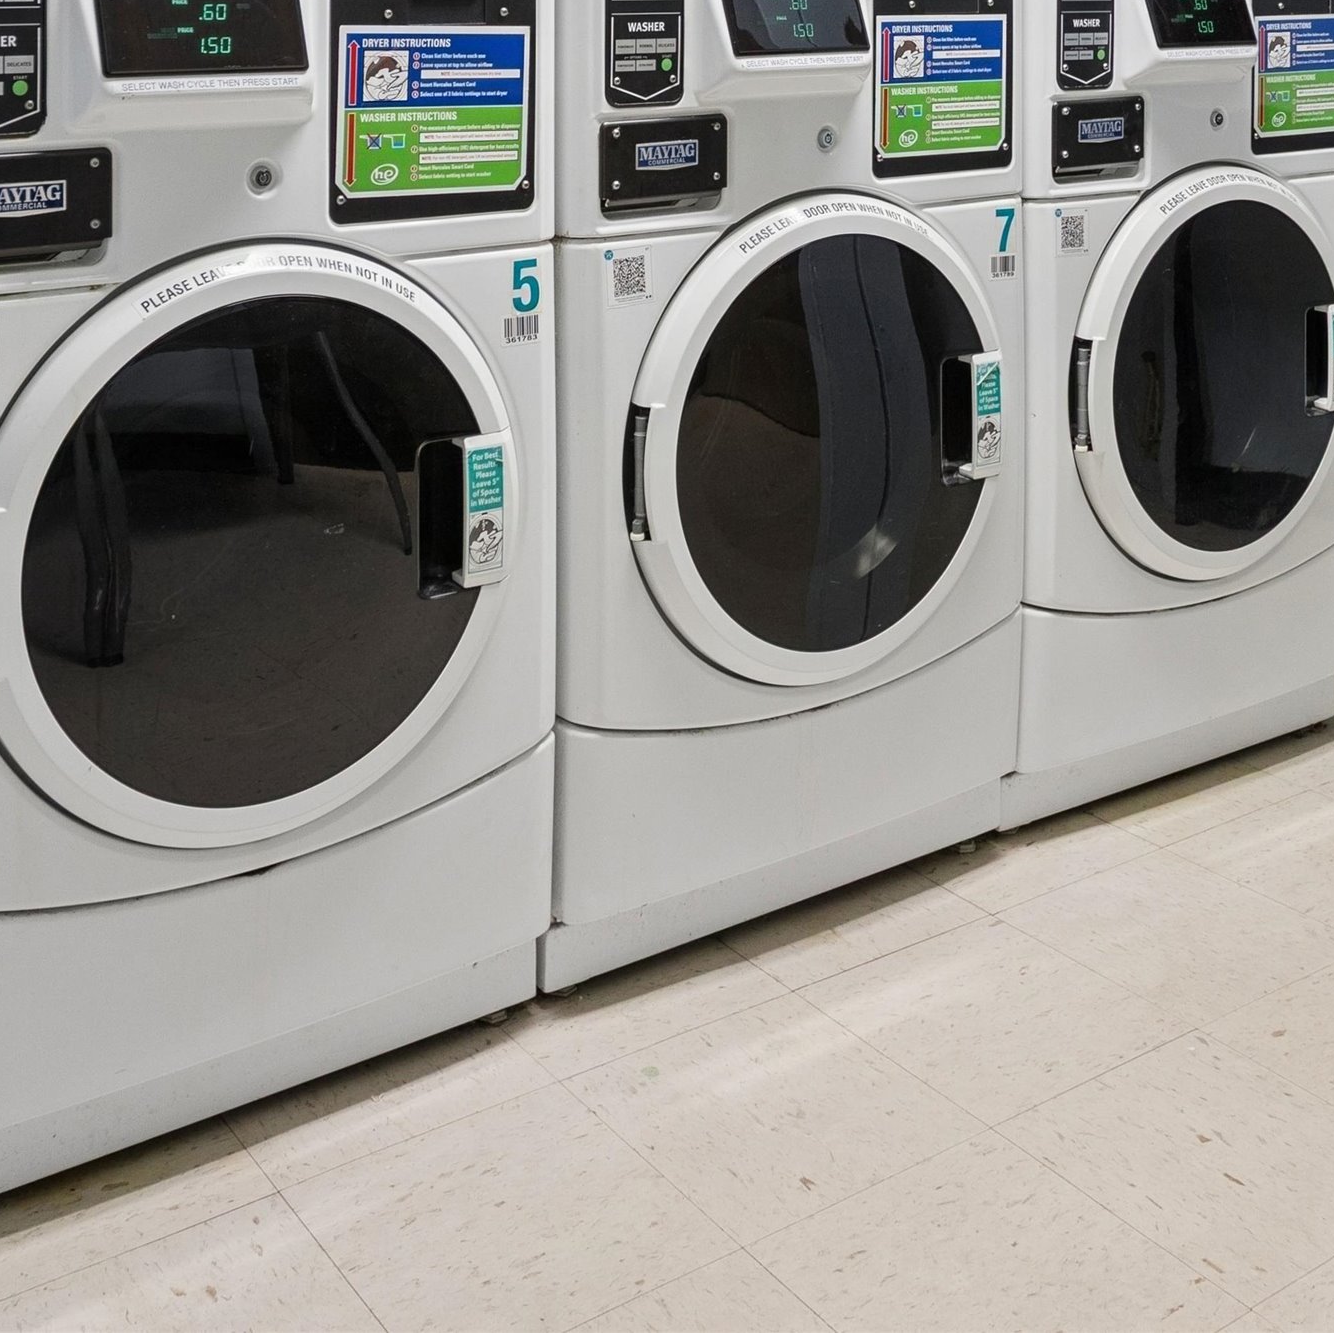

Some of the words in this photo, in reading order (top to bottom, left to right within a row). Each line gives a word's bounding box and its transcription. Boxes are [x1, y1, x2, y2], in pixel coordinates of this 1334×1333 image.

[199, 4, 227, 21] .60
[628, 21, 665, 32] WASHER
[1073, 18, 1100, 28] WASHER
[201, 37, 232, 54] 1.50
[122, 82, 158, 92] SELECT
[159, 81, 186, 90] WASH
[187, 80, 216, 89] CYCLE
[216, 79, 242, 88] THEN
[243, 78, 271, 87] PRESS
[272, 77, 299, 86] START
[1081, 120, 1122, 135] MAYTAG
[639, 143, 695, 161] MAYTAG
[1159, 191, 1187, 215] PLEASE
[1186, 180, 1209, 196] LEAVE
[1207, 175, 1227, 186] DOOR
[1227, 173, 1247, 182] OPEN
[739, 225, 776, 254] PLEASE
[803, 204, 832, 219] DOOR
[832, 202, 857, 212] OPEN
[857, 204, 884, 215] WHEN
[885, 210, 902, 222] NOT
[995, 208, 1015, 252] 7
[140, 279, 196, 313] PLEASE
[278, 256, 313, 267] OPEN
[315, 257, 353, 274] WHEN
[355, 266, 378, 282] NOT
[381, 276, 393, 288] IN
[395, 283, 417, 303] USE
[512, 258, 540, 313] 5
[505, 334, 538, 345] 361783
